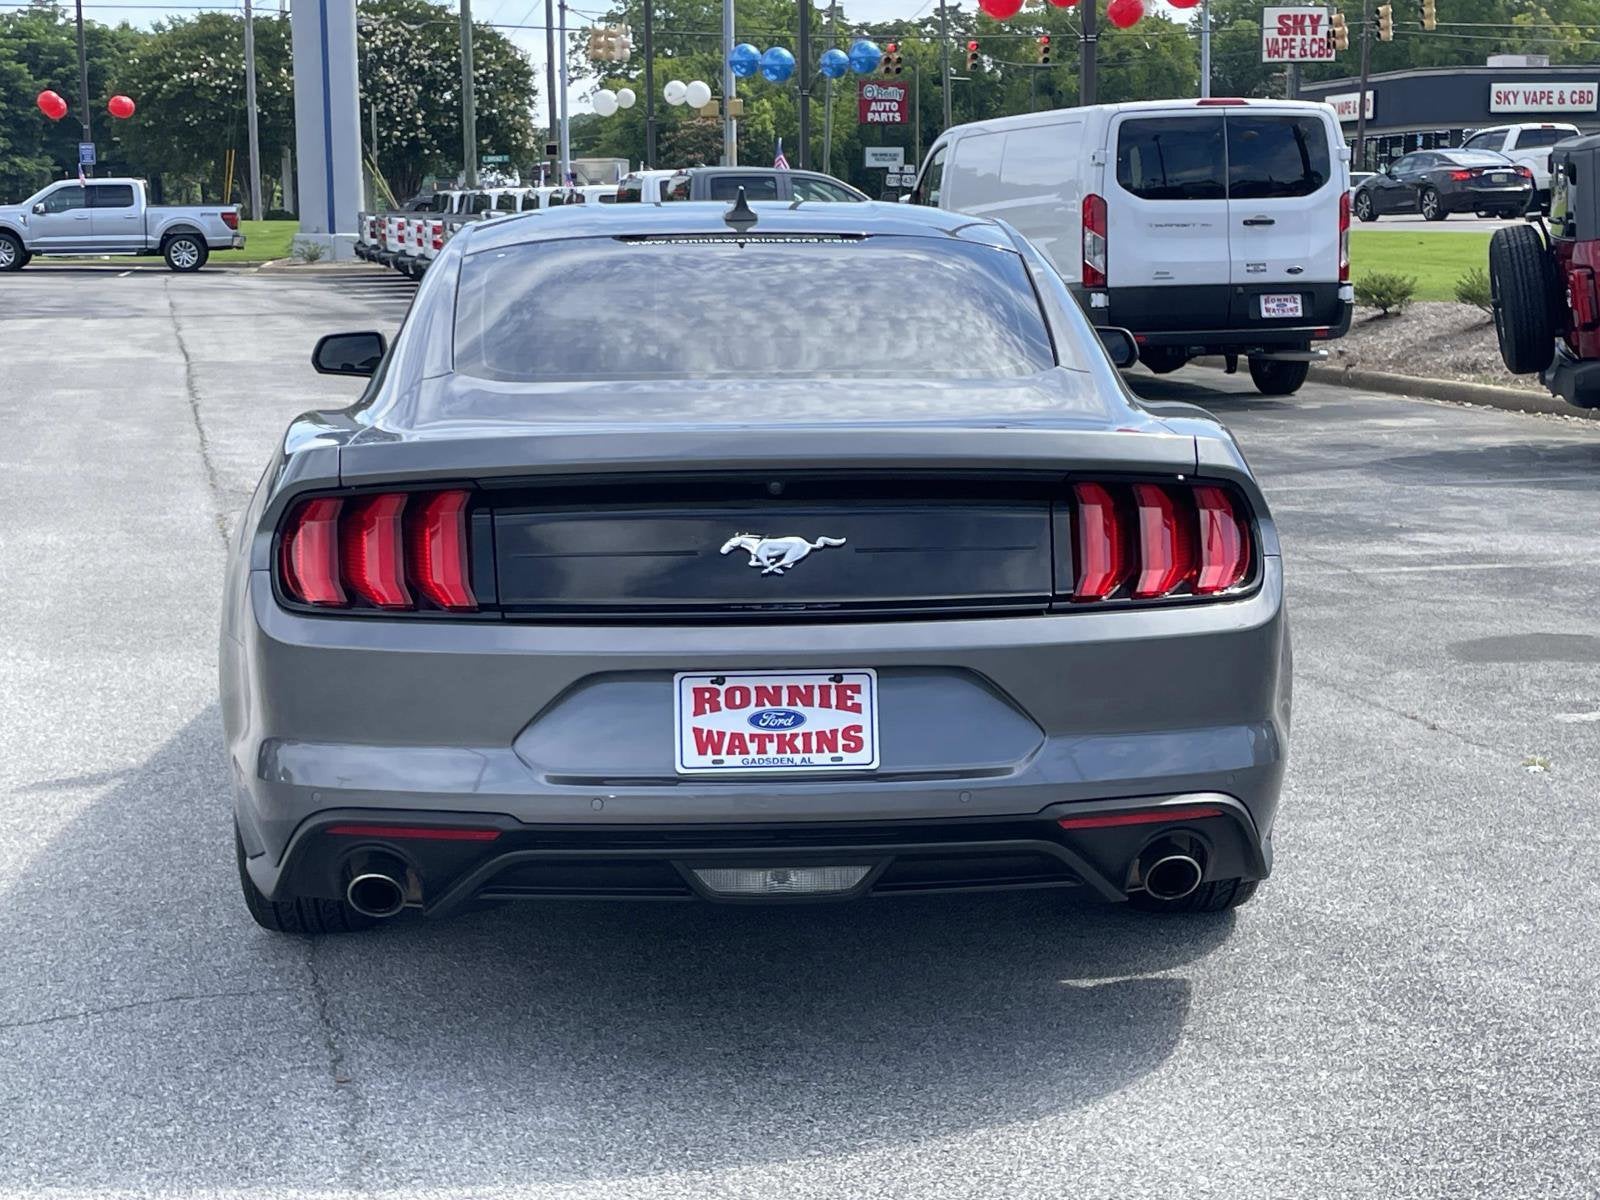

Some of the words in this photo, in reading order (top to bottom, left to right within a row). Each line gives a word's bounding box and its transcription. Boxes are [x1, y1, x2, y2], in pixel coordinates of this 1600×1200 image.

[1277, 14, 1322, 36] SKY
[1266, 37, 1296, 59] VAPE
[1299, 37, 1307, 59] &
[864, 85, 904, 101] O'Reilly
[1495, 90, 1519, 105] SKY
[1523, 90, 1553, 105] VAPE
[1557, 90, 1566, 105] &
[1570, 90, 1594, 105] CBD
[870, 102, 898, 111] AUTO
[867, 112, 901, 122] PARTS
[693, 684, 862, 717] RONNIE
[759, 712, 794, 726] Ford
[693, 724, 864, 756] WATKINS
[742, 757, 797, 766] GADSDEN,
[800, 757, 814, 765] AL
